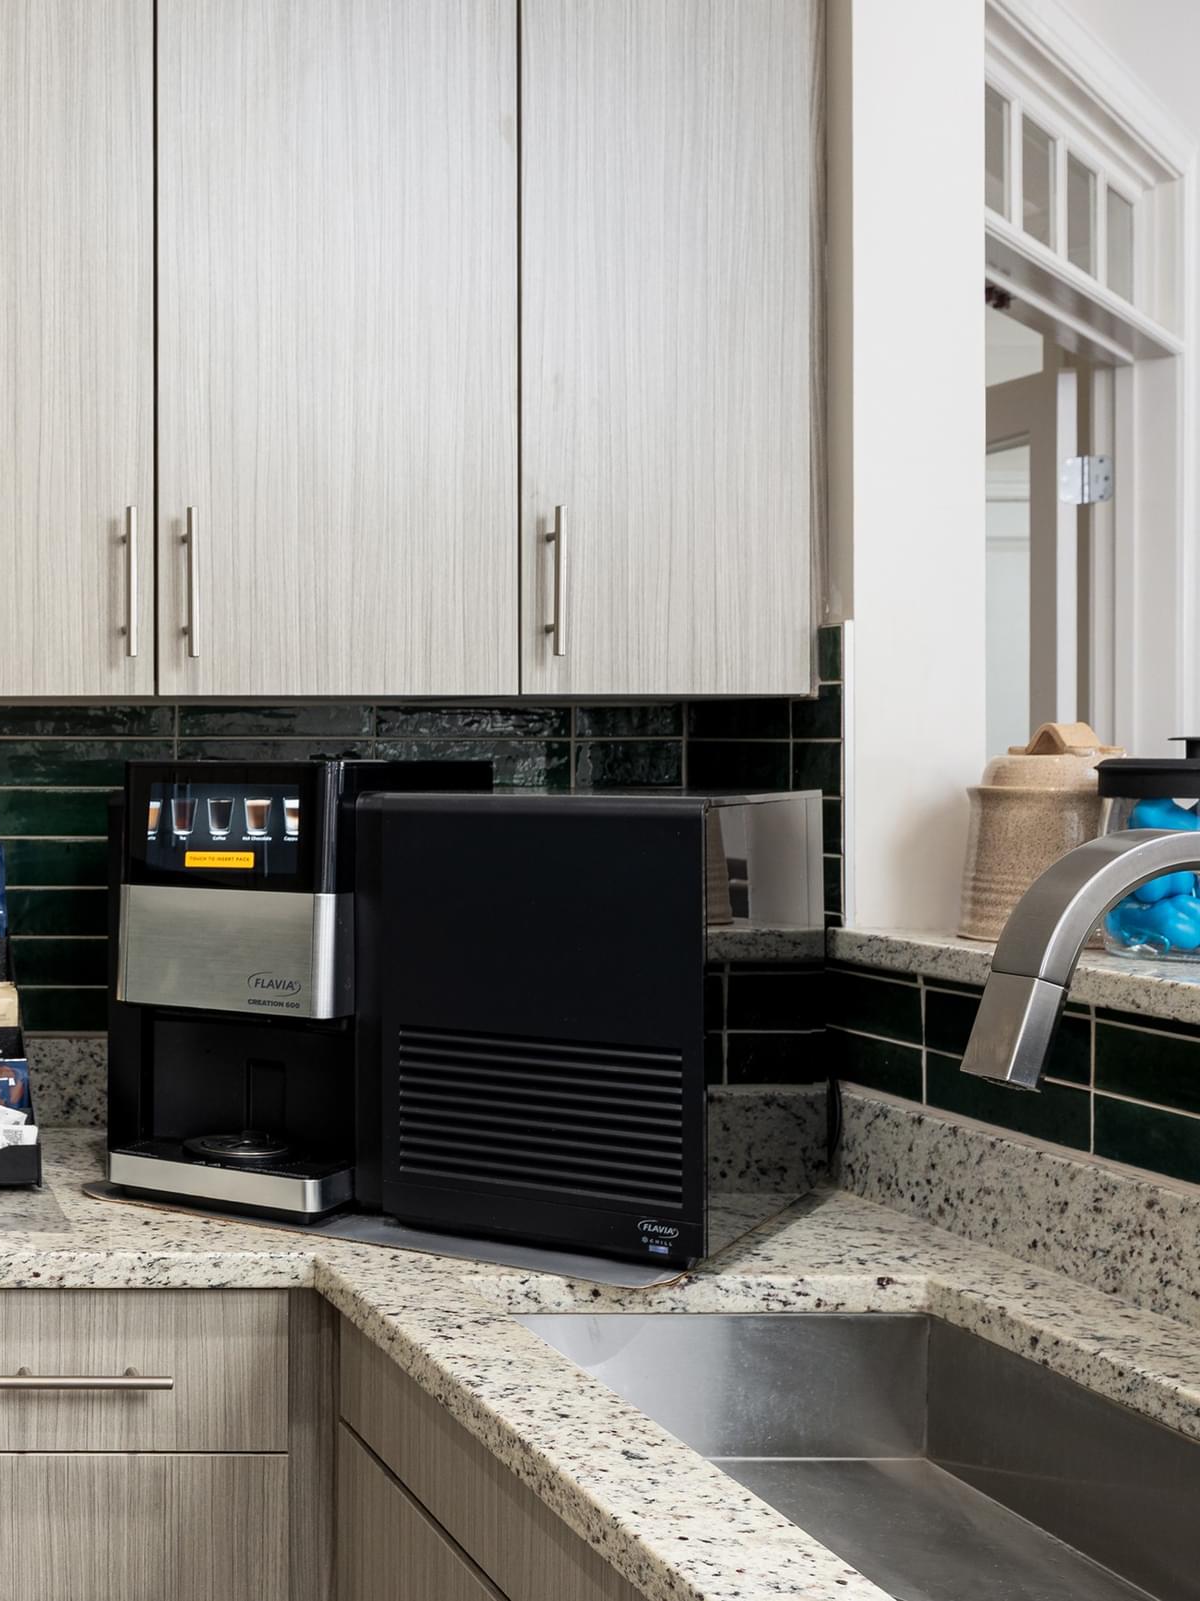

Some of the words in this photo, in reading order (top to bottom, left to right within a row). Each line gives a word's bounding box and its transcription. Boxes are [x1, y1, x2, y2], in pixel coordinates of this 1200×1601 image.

[247, 998, 284, 1008] CREATION
[642, 1223, 675, 1236] FLAVIA
[649, 1238, 673, 1247] CHILL
